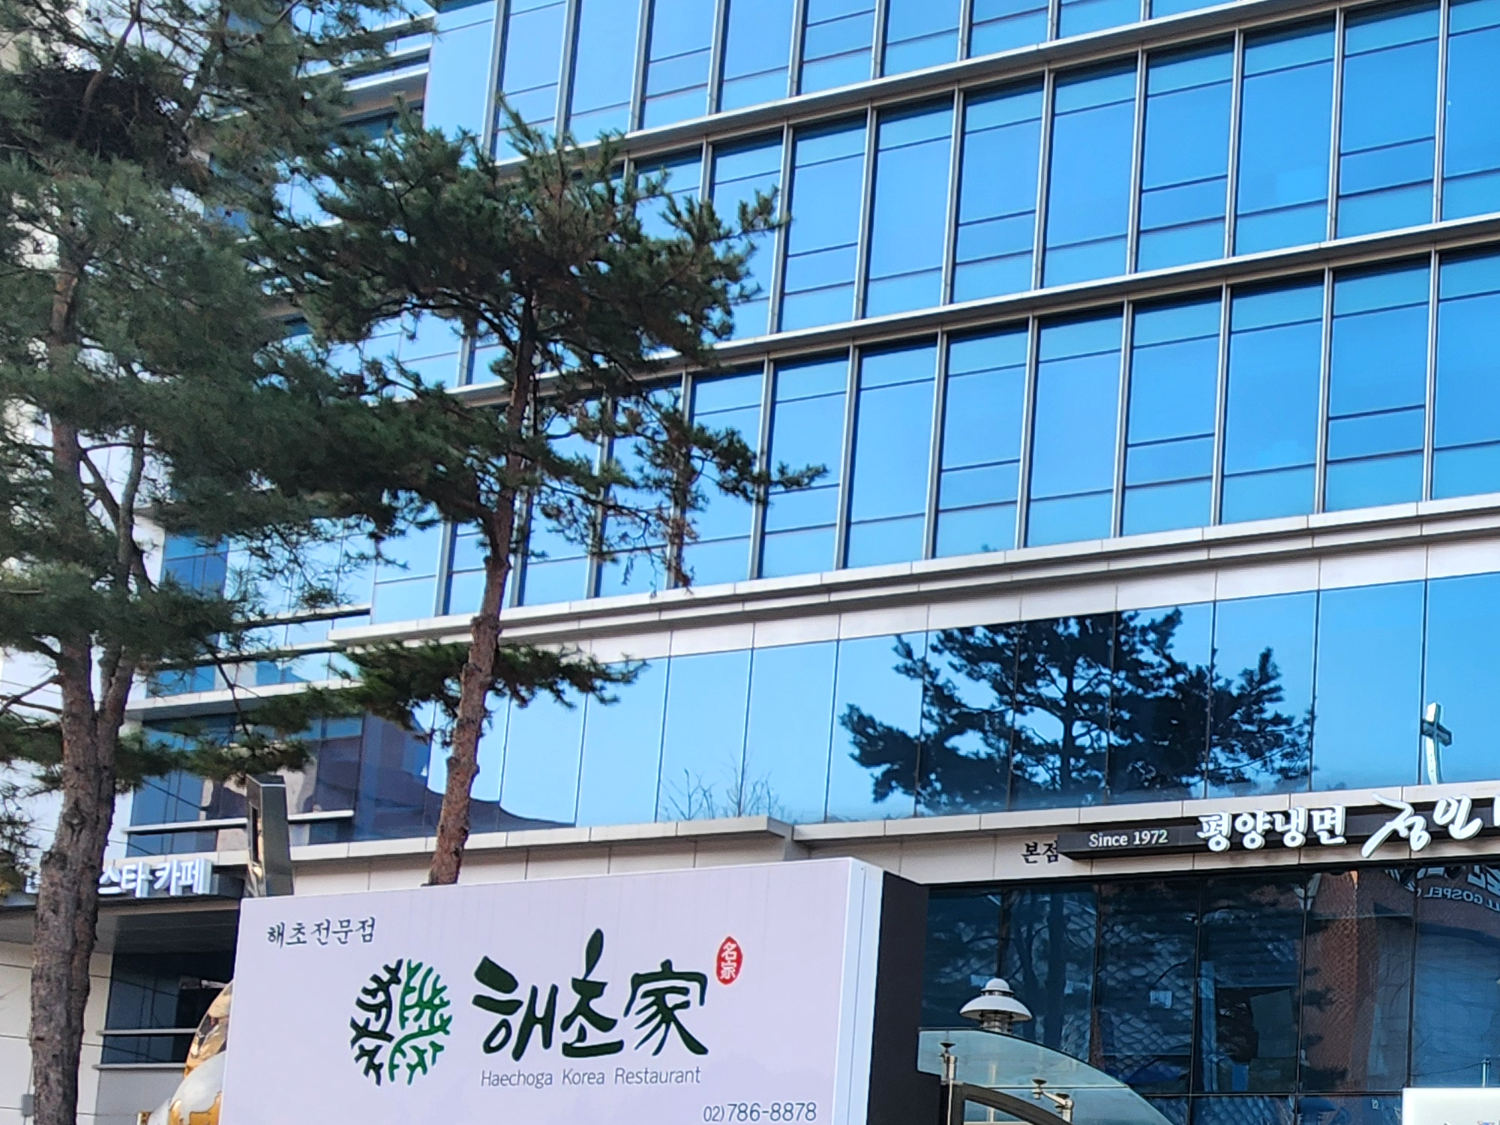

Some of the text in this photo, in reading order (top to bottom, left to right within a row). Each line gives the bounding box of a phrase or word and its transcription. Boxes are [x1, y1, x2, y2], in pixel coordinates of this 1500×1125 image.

[1089, 830, 1168, 848] Since 1972
[1197, 805, 1347, 852] 평양냉면
[1021, 841, 1059, 864] 본점
[153, 858, 209, 896] 카페
[266, 917, 376, 948] 해초전문점
[481, 1065, 701, 1088] Haechoga Korea Restaurant
